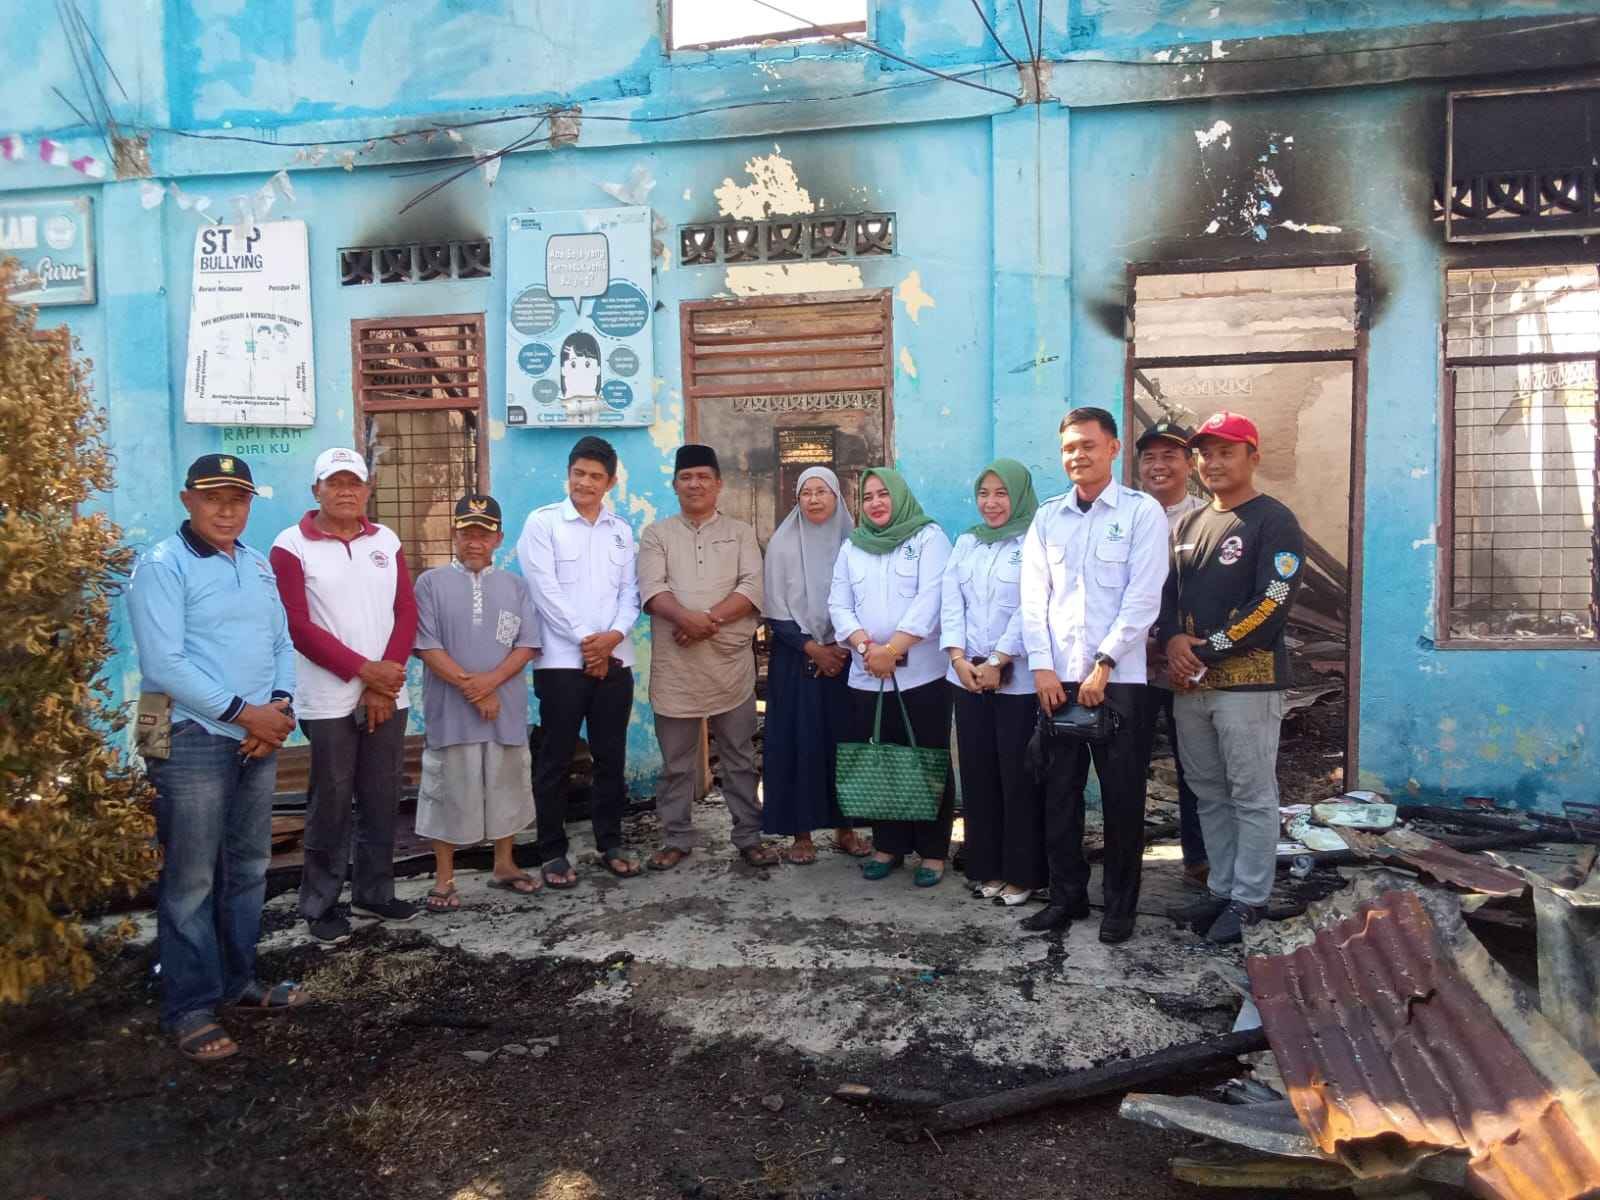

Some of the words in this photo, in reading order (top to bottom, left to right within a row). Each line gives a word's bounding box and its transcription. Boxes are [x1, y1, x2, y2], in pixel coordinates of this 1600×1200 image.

[202, 226, 261, 255] STP
[200, 254, 263, 270] BULLYING
[39, 256, 80, 292] Guru
[224, 426, 260, 440] RAPI
[236, 444, 264, 454] DIRI
[270, 443, 290, 454] KU
